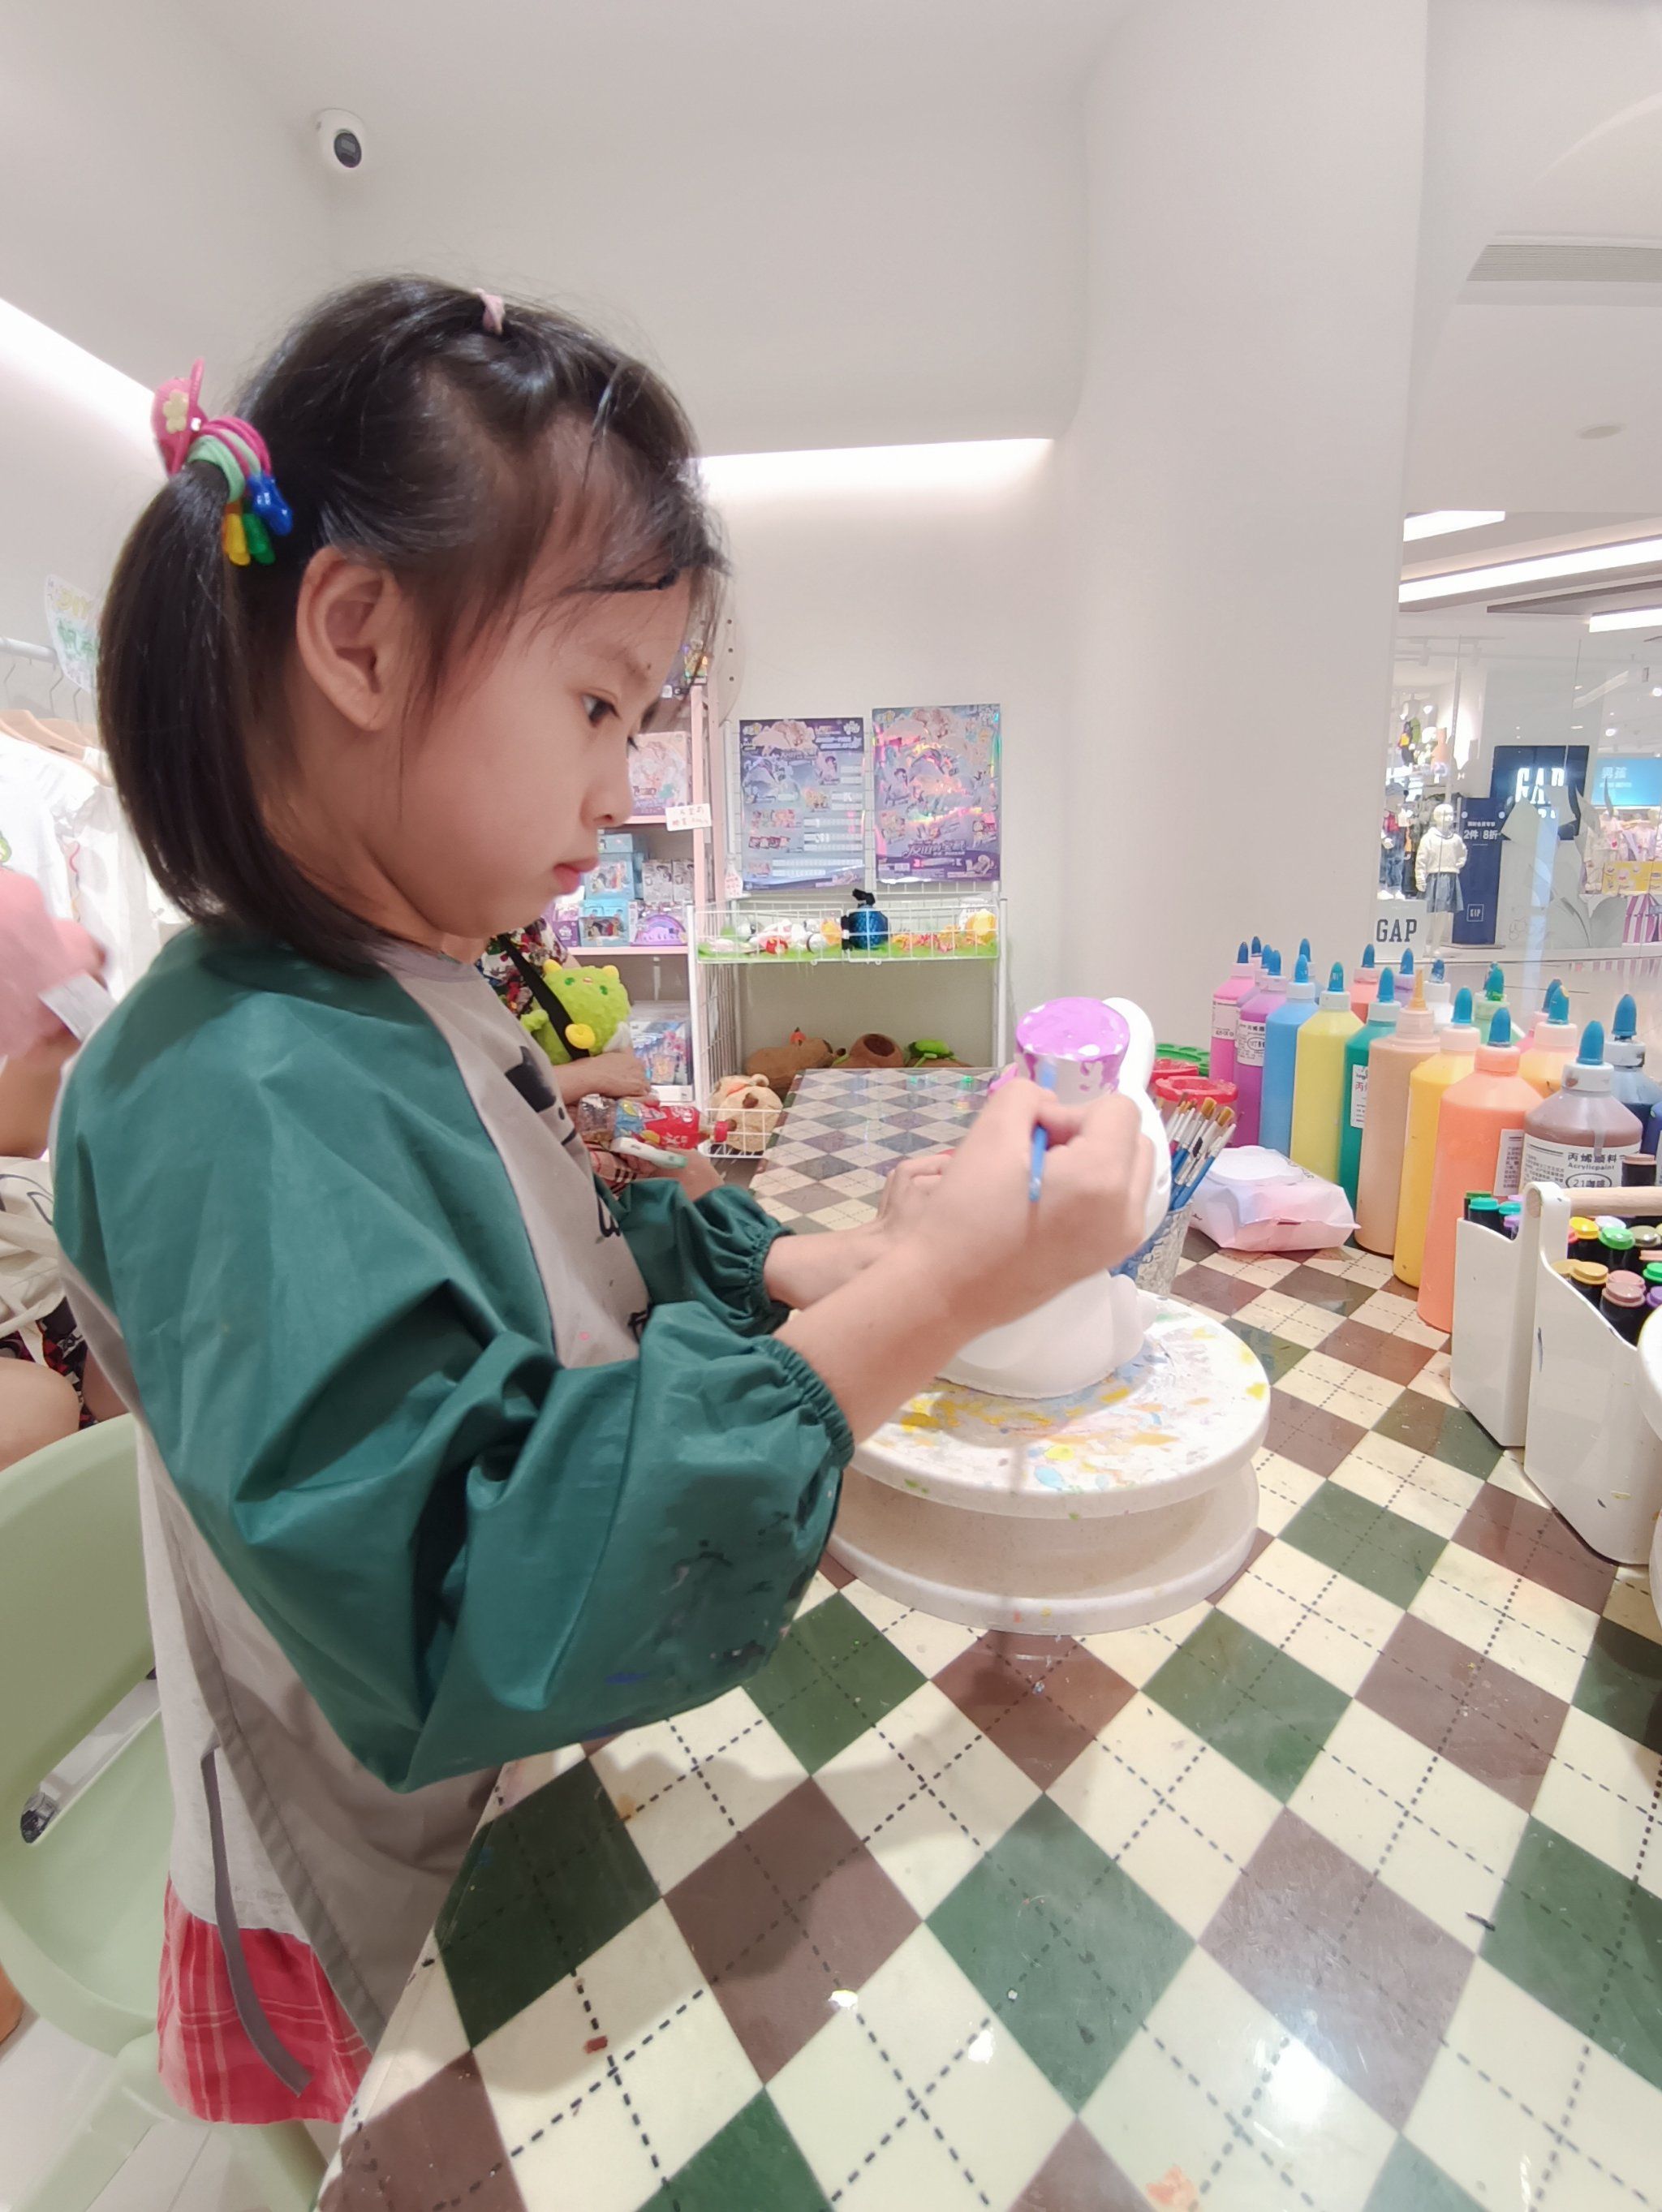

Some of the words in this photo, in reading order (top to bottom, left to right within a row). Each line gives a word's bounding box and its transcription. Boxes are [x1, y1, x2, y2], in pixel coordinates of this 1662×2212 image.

[1463, 829, 1479, 840] 2件
[1376, 919, 1417, 942] GAP
[1568, 1162, 1615, 1171] Acrylicpaint
